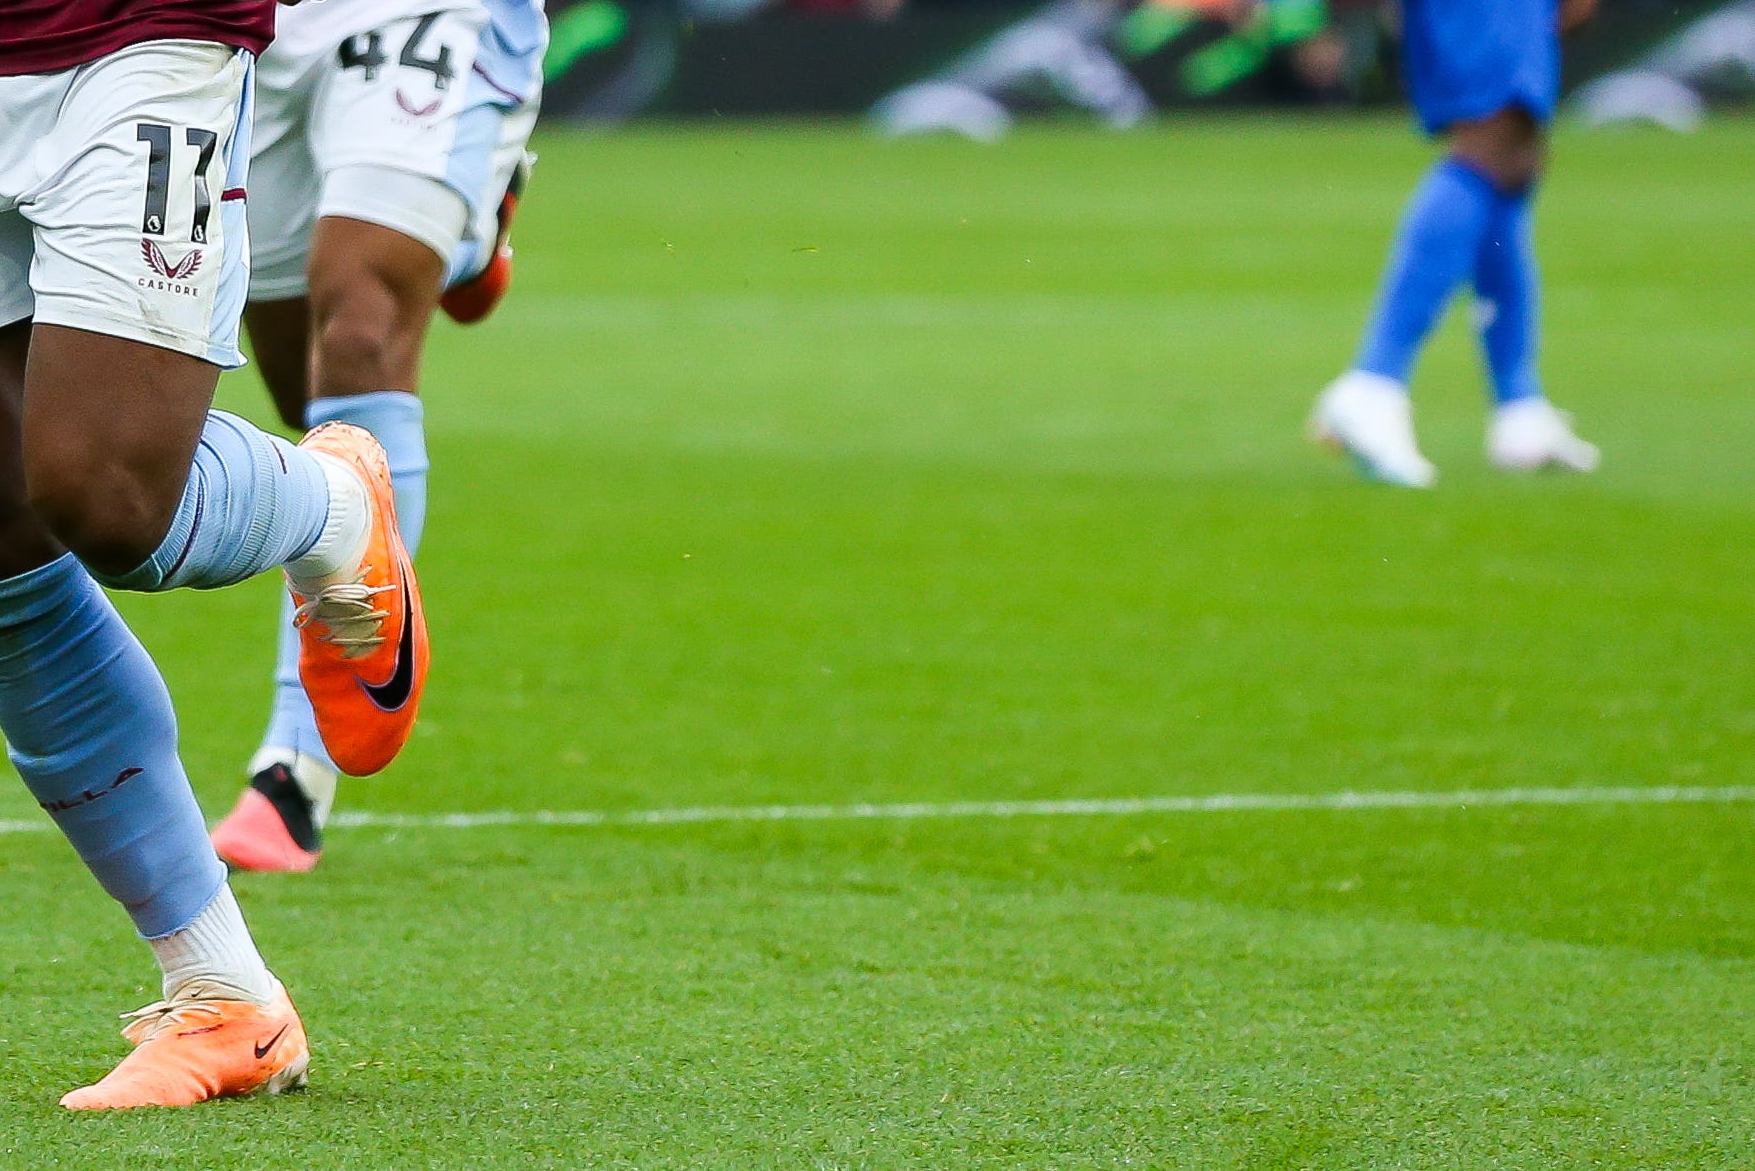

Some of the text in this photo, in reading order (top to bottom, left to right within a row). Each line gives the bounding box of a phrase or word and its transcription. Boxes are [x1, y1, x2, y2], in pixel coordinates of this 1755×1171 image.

[338, 9, 455, 90] 44
[135, 123, 219, 246] 11
[137, 278, 199, 298] CASTORE
